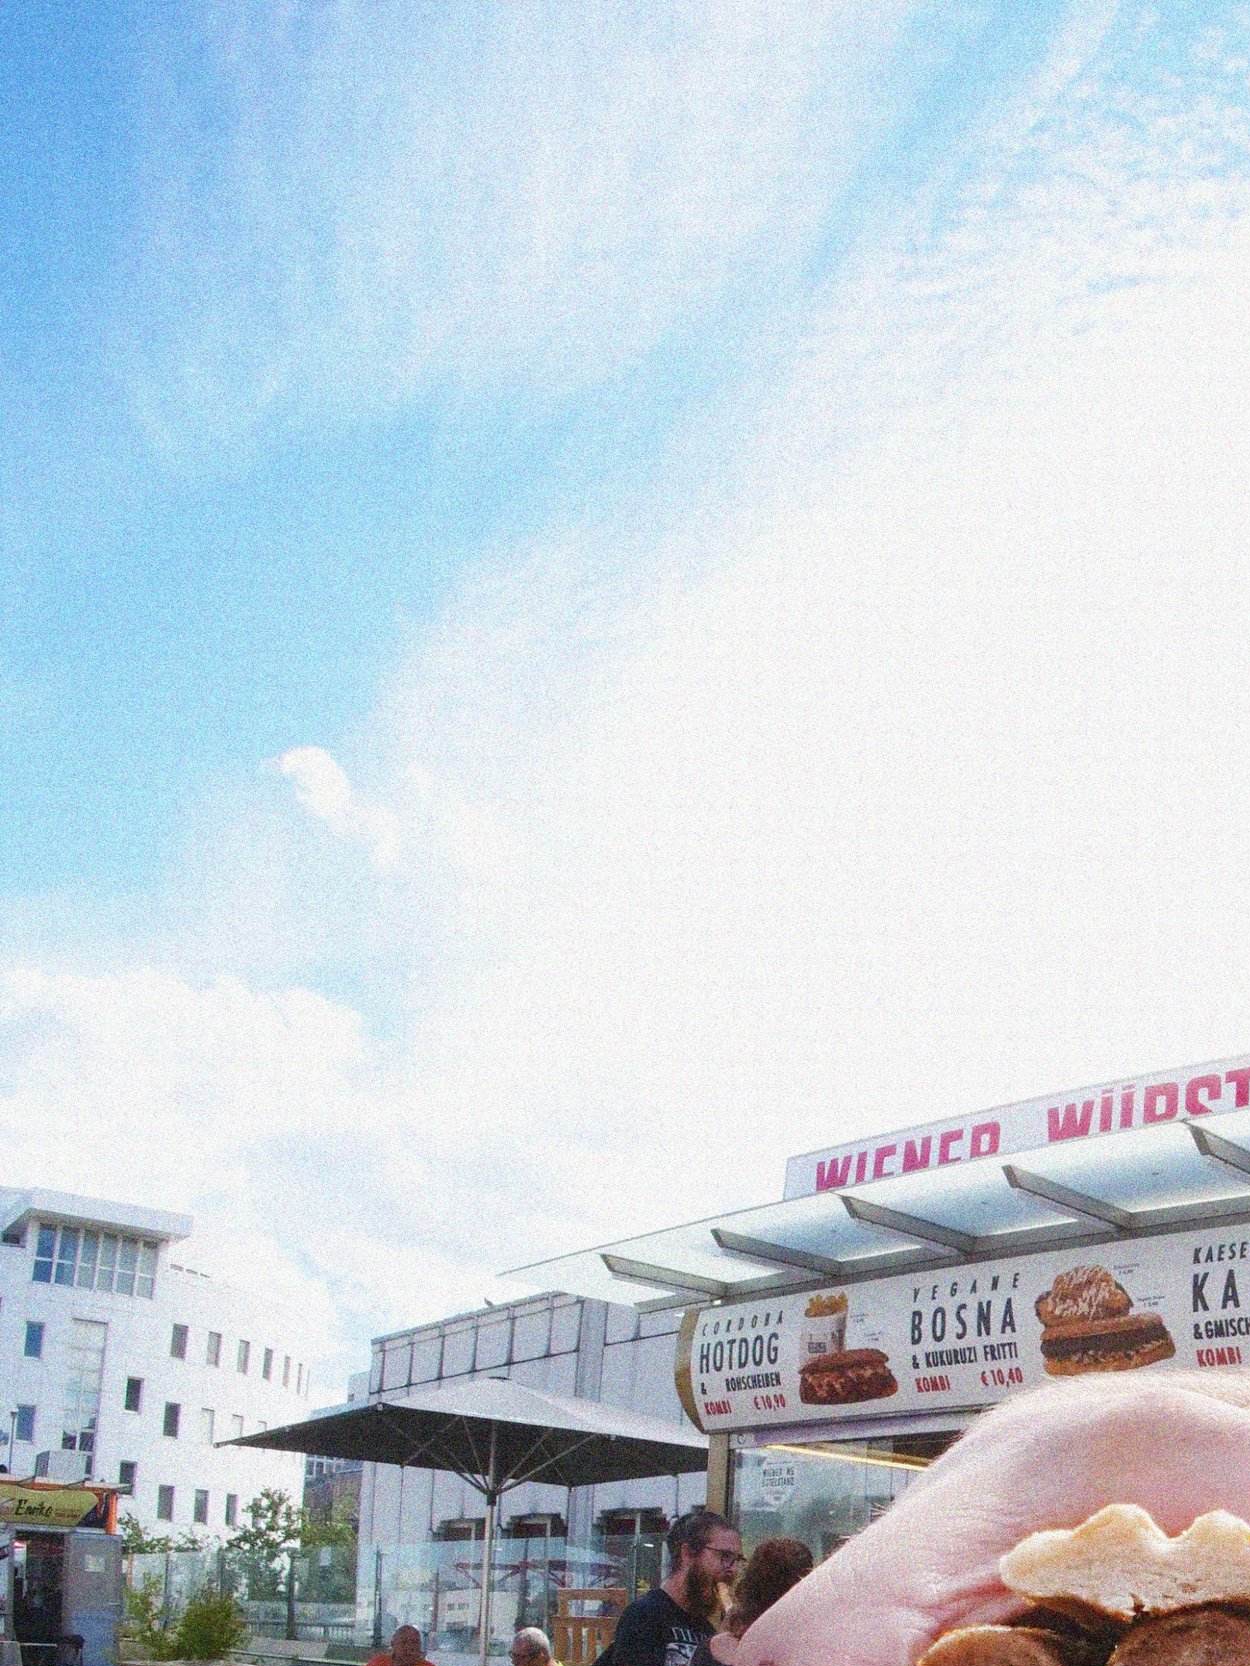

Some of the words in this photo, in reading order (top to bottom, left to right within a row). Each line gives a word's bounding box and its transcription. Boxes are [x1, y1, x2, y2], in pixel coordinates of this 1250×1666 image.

[913, 1272, 1020, 1302] VEGANE
[702, 1311, 784, 1336] CORDOBA
[911, 1297, 1016, 1345] BOSNA
[1193, 1323, 1203, 1340] &
[699, 1332, 779, 1374] HOTDOG
[911, 1354, 920, 1369] &
[925, 1347, 978, 1368] KUKURUZI
[983, 1341, 1019, 1362] FRITTI
[1196, 1347, 1242, 1367] KOMBI
[701, 1382, 708, 1395] &
[915, 1375, 951, 1392] KOMBI
[704, 1400, 732, 1416] KOMBI
